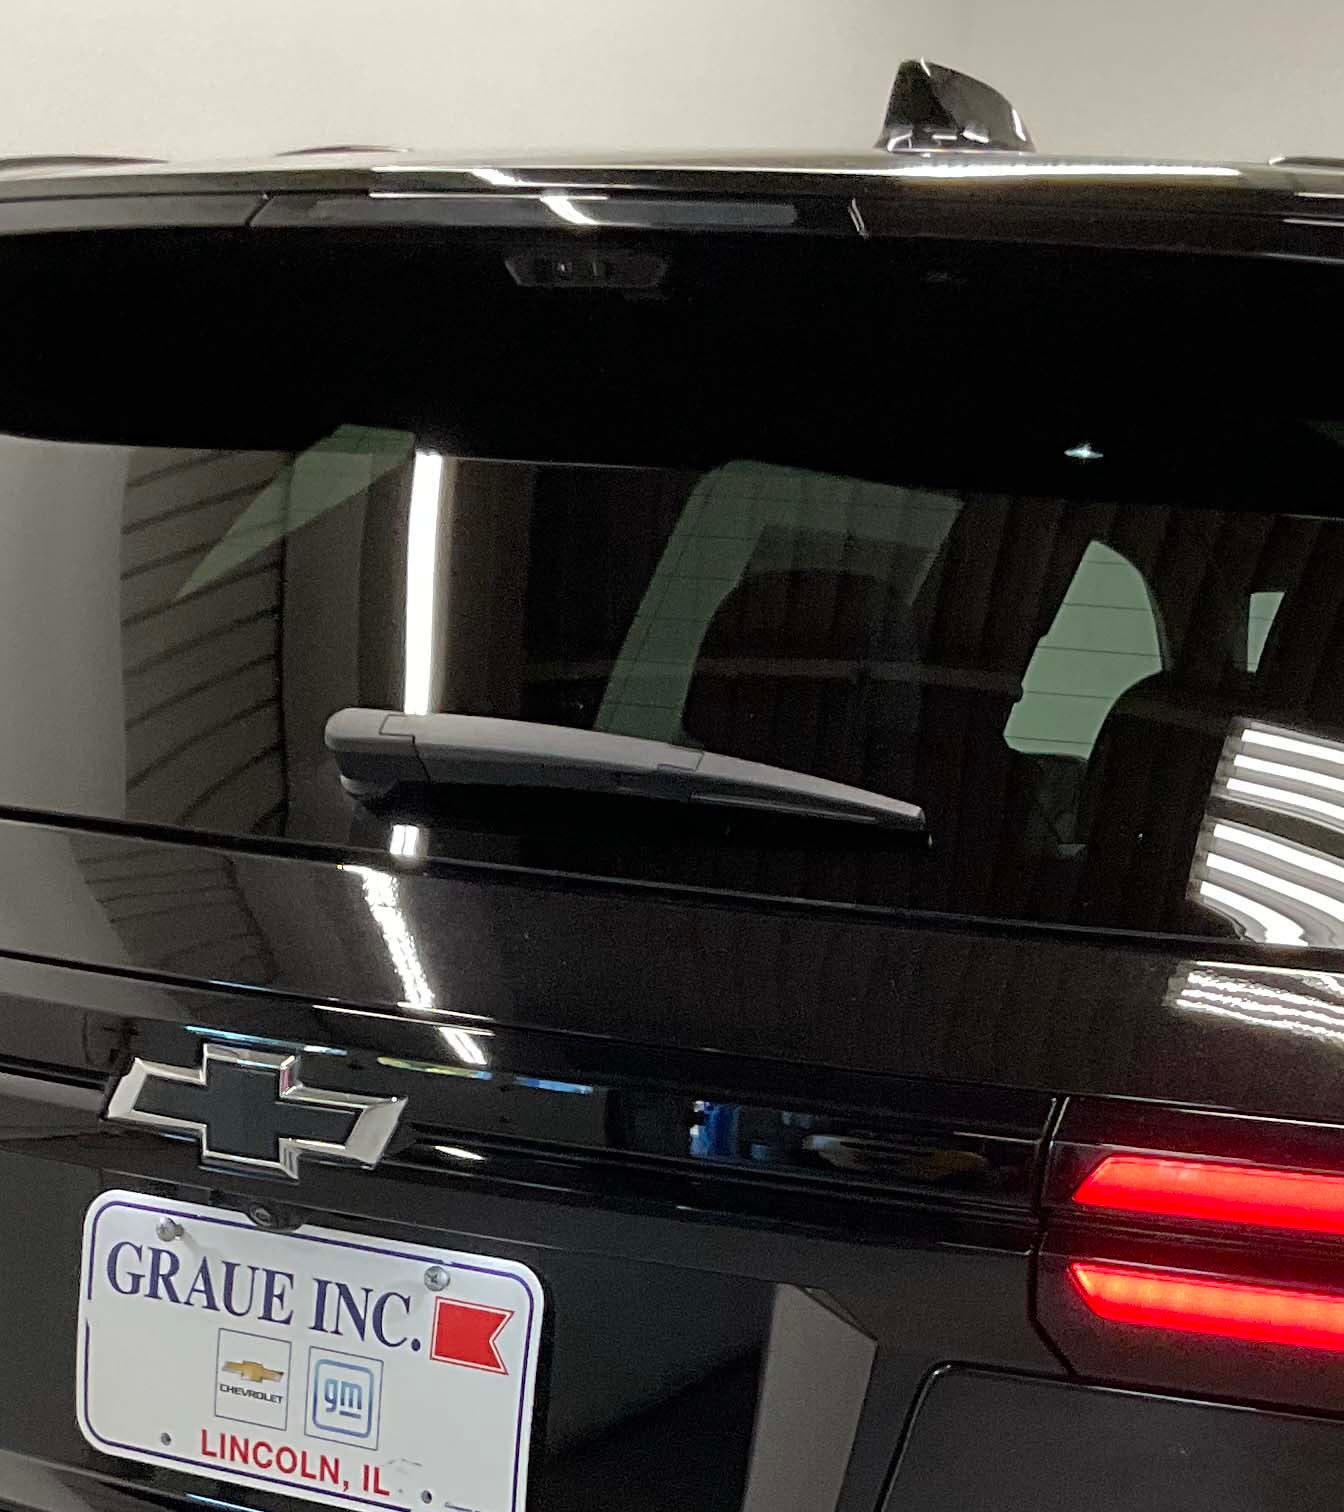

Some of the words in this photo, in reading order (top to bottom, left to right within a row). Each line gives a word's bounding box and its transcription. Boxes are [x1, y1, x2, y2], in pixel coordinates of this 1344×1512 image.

[106, 1241, 294, 1326] GRAUE
[308, 1279, 423, 1353] INC.
[219, 1383, 284, 1404] CHEVROLET
[200, 1428, 350, 1493] LINCOLN,
[363, 1464, 390, 1497] IL
